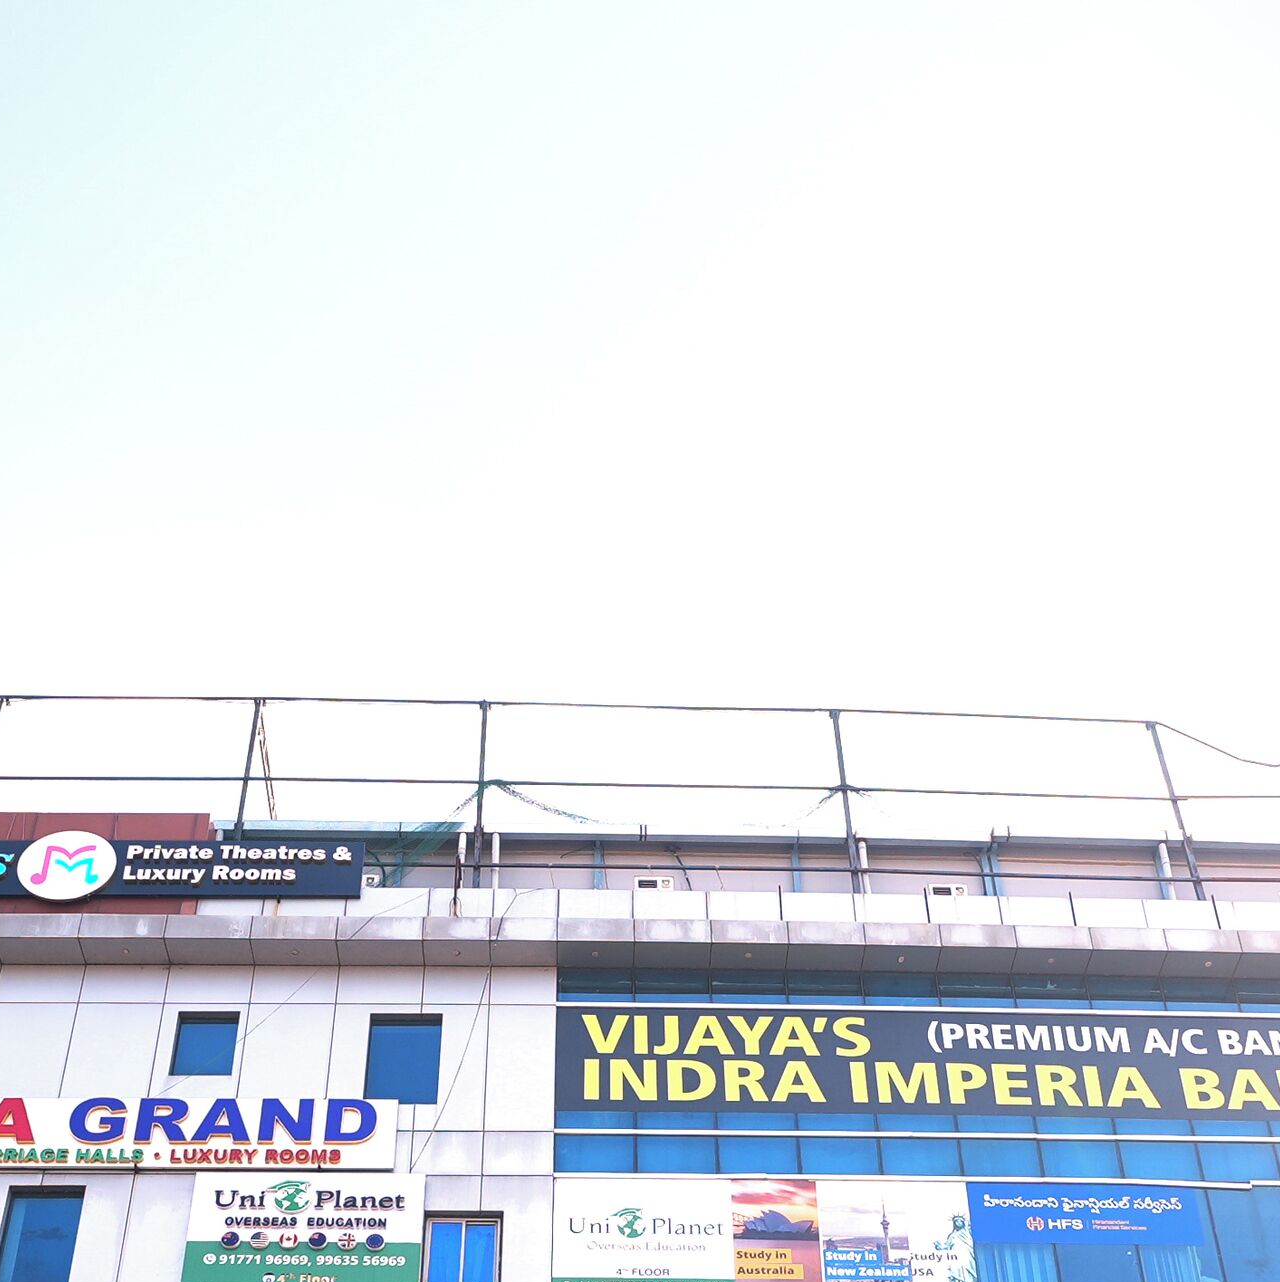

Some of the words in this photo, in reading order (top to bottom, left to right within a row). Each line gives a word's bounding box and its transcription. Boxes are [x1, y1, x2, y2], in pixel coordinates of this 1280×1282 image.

[126, 844, 213, 860] Private
[220, 844, 326, 861] Theatres
[332, 845, 352, 861] &
[123, 865, 205, 884] Luxury
[212, 865, 296, 881] Rooms
[581, 1014, 872, 1058] VIJAYA'S
[927, 1020, 1130, 1054] (PREMIUM
[1144, 1028, 1208, 1058] A/C
[583, 1059, 826, 1103] INDRA
[849, 1061, 1162, 1109] IMPERIA
[69, 1097, 378, 1144] GRAND
[75, 1148, 144, 1164] HALLS
[170, 1148, 256, 1164] LUXURY
[265, 1148, 342, 1165] ROOMS
[215, 1190, 266, 1210] Uni
[314, 1190, 406, 1211] Planet
[225, 1216, 298, 1227] OVERSEAS
[307, 1216, 387, 1229] EDUCATION
[569, 1217, 611, 1234] Uni
[652, 1217, 725, 1236] Planet
[1048, 1218, 1084, 1230] HFS
[219, 1255, 261, 1265] 91771
[265, 1255, 312, 1267] 96969,
[316, 1255, 359, 1266] 99635
[363, 1256, 406, 1267] 56969
[736, 1250, 772, 1262] Study
[775, 1251, 787, 1260] in
[825, 1250, 863, 1262] Study
[865, 1251, 877, 1261] in
[946, 1252, 958, 1261] in
[631, 1268, 670, 1277] FLOOR
[737, 1265, 795, 1275] Australia
[827, 1266, 858, 1277] New
[860, 1266, 909, 1277] Zealand
